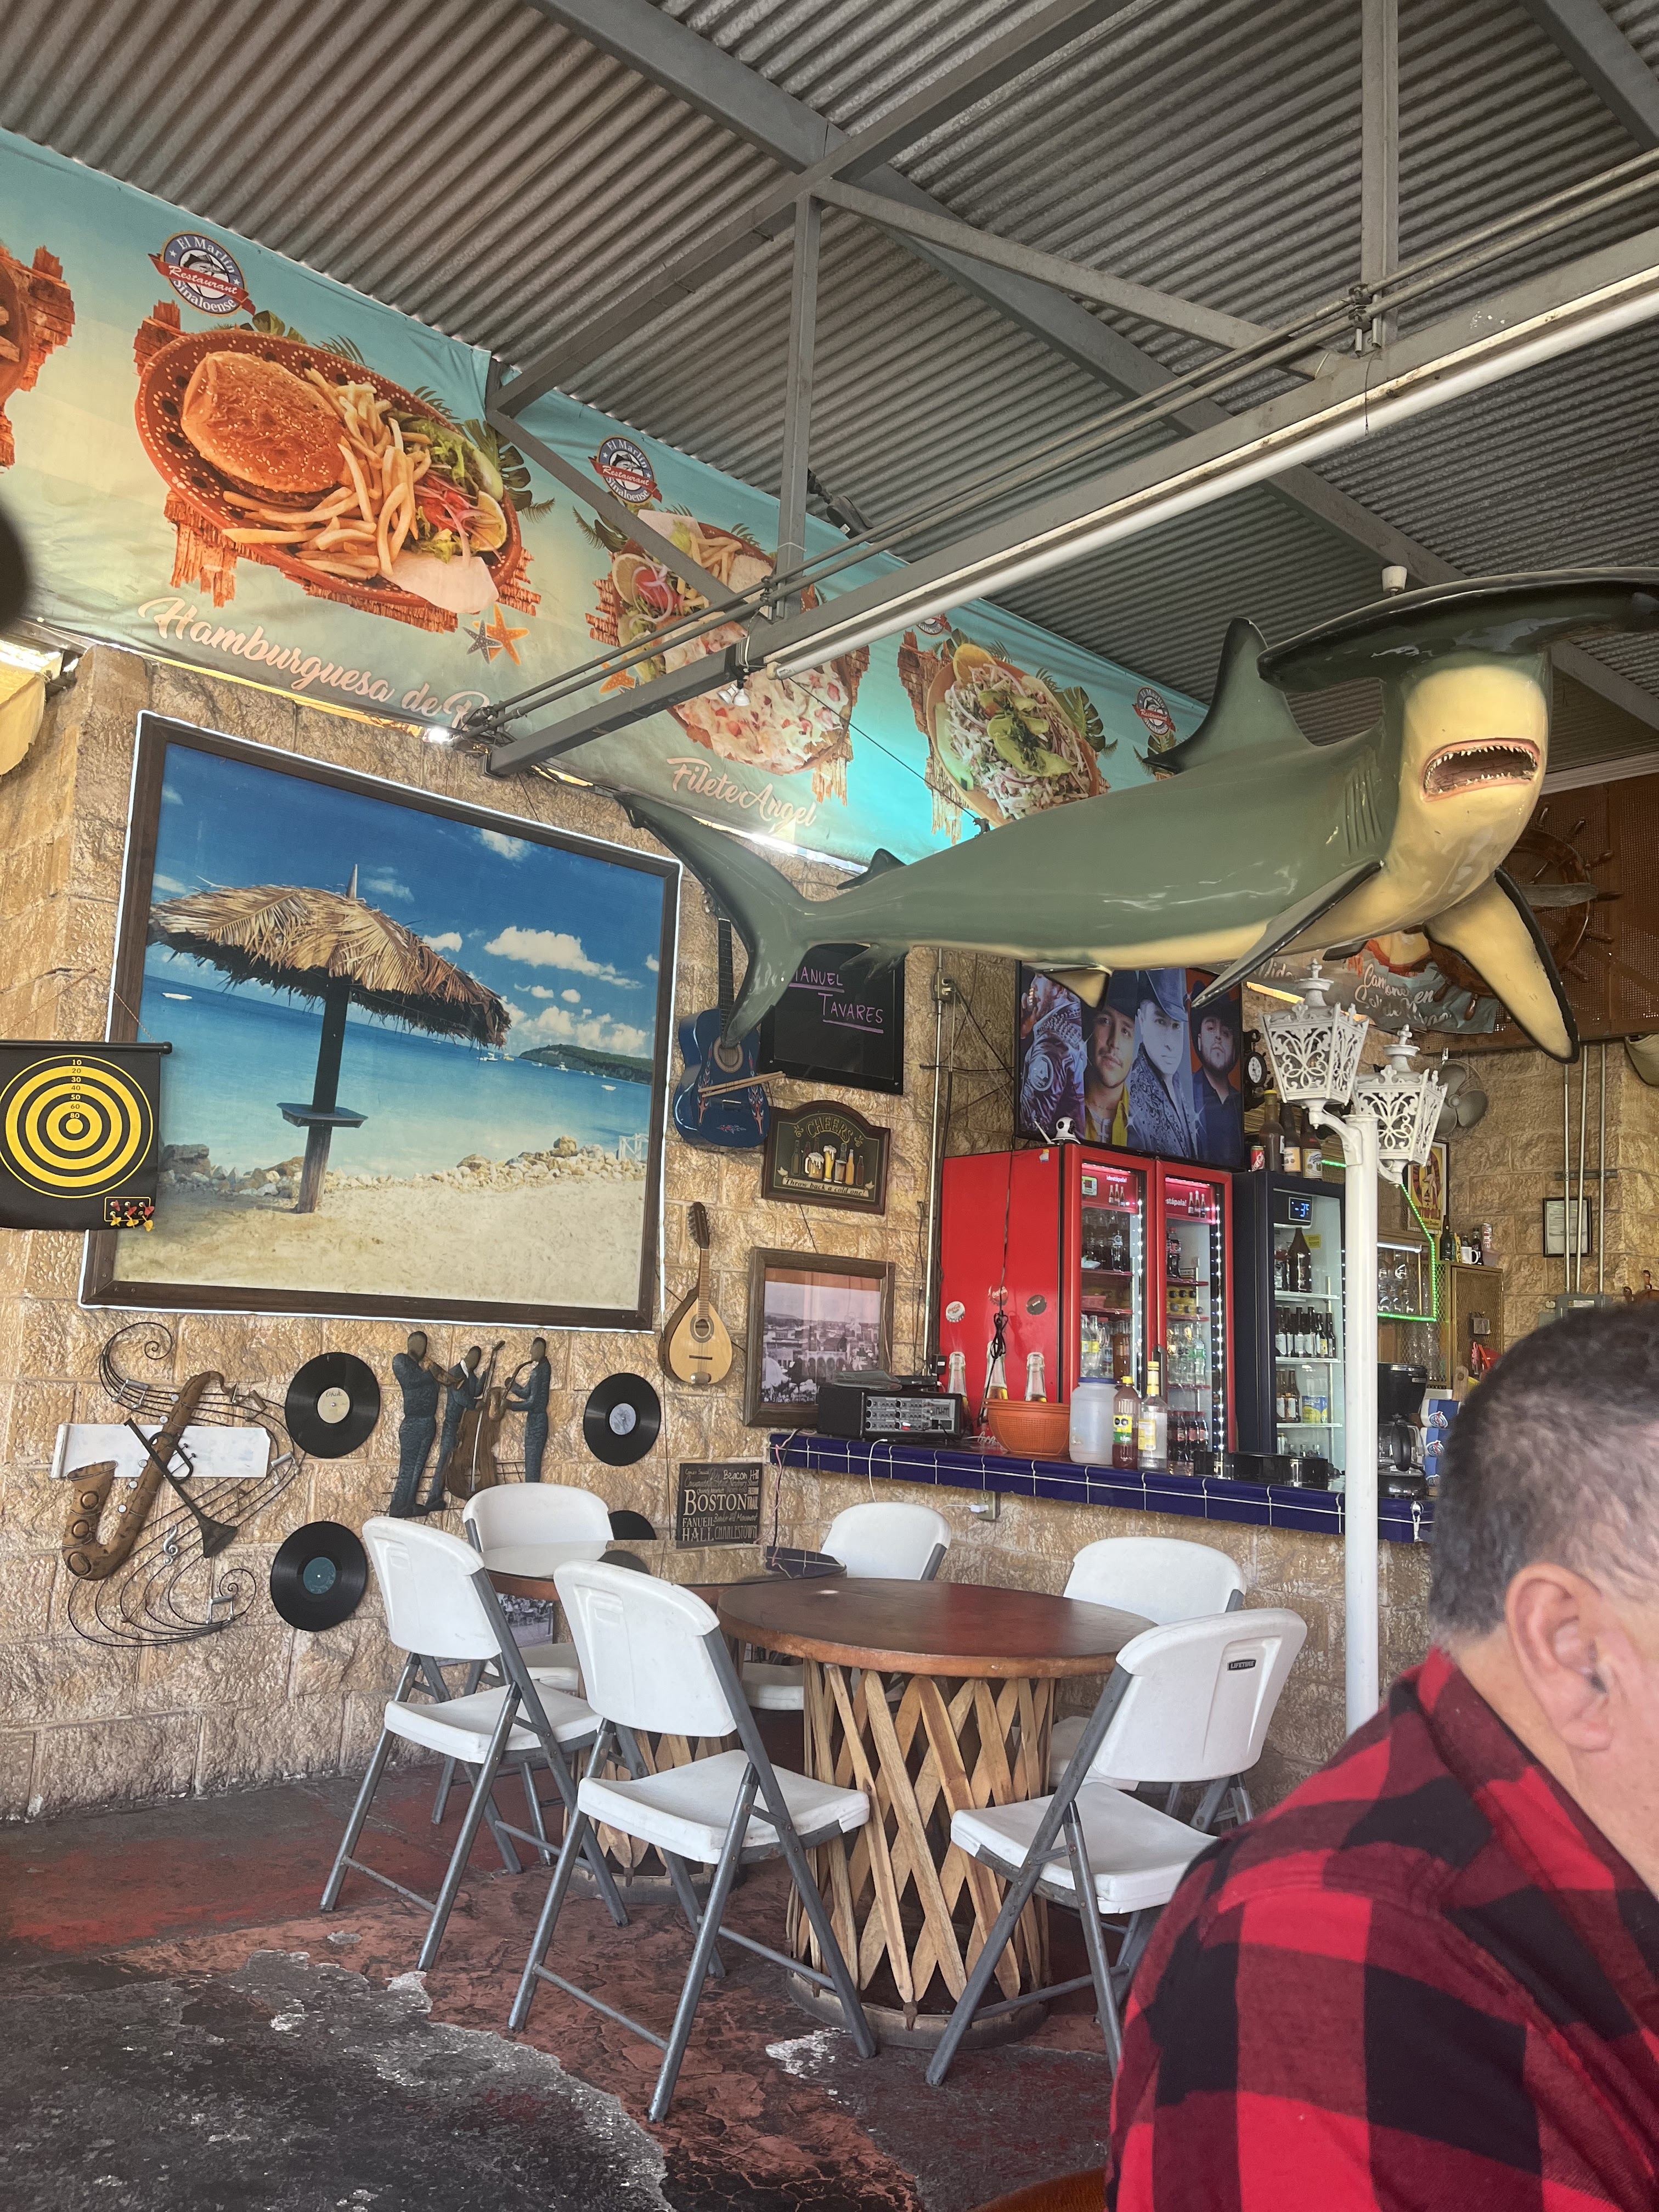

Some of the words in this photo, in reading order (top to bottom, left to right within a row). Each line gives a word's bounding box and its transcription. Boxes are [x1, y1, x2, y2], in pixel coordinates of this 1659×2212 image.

[176, 236, 191, 250] El
[194, 236, 235, 273] Marlín
[168, 265, 238, 294] Restaurant
[173, 280, 236, 313] Sinaloense
[606, 440, 617, 450] El
[618, 439, 647, 468] Marlín
[602, 465, 650, 486] Restaurant
[606, 476, 649, 501] Sinaloense
[138, 597, 395, 702] Hamburguesa
[402, 683, 443, 716] de
[795, 966, 843, 986] ANUEL
[818, 992, 883, 1023] TAVARES
[806, 1116, 854, 1143] CHEERS
[785, 1178, 808, 1187] Throw
[723, 1469, 748, 1480] Beacon
[684, 1489, 748, 1516] BOSTON
[682, 1517, 715, 1527] FANUEIL
[682, 1527, 714, 1542] HALL
[714, 1525, 758, 1540] CHARLESTOWN
